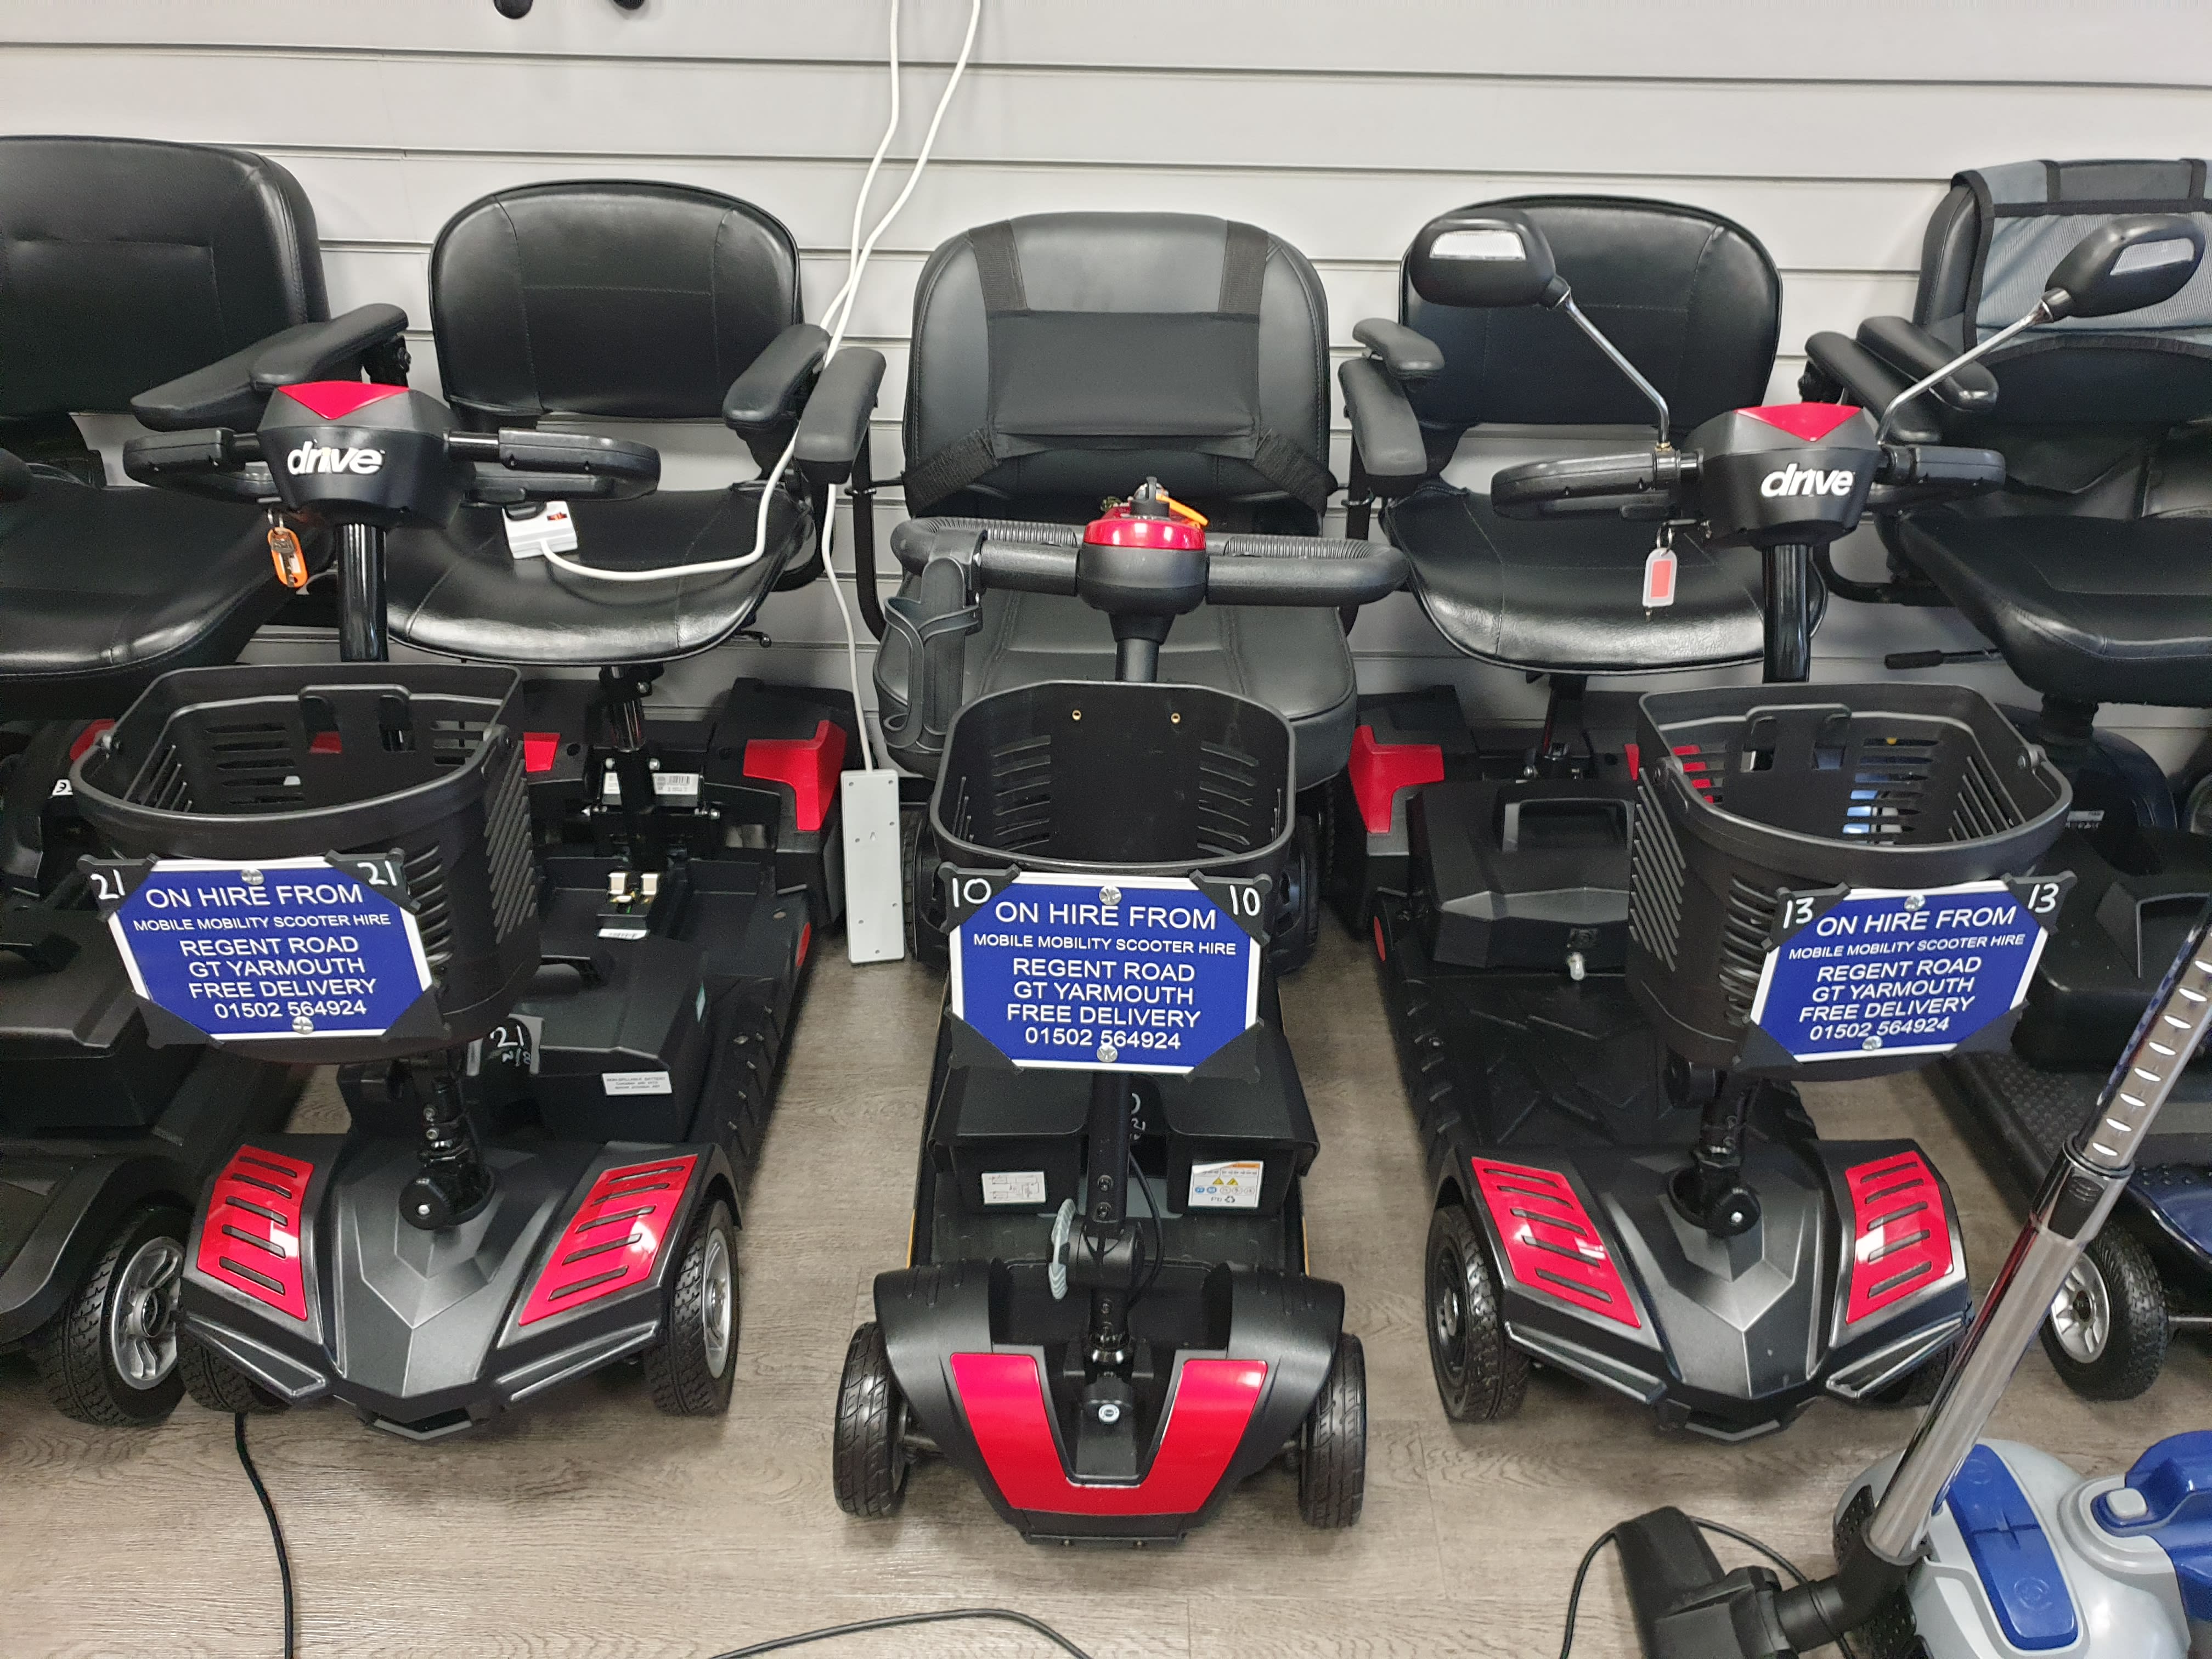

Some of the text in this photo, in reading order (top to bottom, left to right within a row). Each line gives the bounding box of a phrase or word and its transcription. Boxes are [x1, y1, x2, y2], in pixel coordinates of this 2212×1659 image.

[287, 441, 383, 475] drive
[1761, 463, 1854, 497] drive
[91, 870, 125, 900] 21
[357, 860, 397, 886] 21
[146, 884, 363, 908] ON HIRE FROM
[952, 878, 991, 907] 10
[1230, 885, 1260, 916] 10
[2028, 883, 2059, 913] 13
[133, 914, 391, 930] MOBILE MOBILITY SCOOTER HIRE
[996, 901, 1215, 930] ON HIRE FROM
[1783, 897, 1814, 929] 13
[1817, 906, 2016, 936] ON HIRE FROM
[180, 936, 358, 956] REGENT ROAD
[974, 934, 1235, 955] MOBILE MOBILITY SCOOTER HIRE
[1789, 934, 2025, 959] MOBILE MOBILITY SCOOTER HIRE
[189, 957, 365, 977] GT YARMOUTH
[1014, 958, 1194, 981] REGENT ROAD
[1817, 957, 1982, 982] REGENT ROAD
[189, 979, 376, 998] FREE DELIVERY
[1014, 981, 1193, 1005] GT YARMOUTH
[1813, 977, 1975, 1002] GT YARMOUTH
[215, 1000, 366, 1018] 01502 564924
[1008, 1004, 1200, 1028] FREE DELIVERY
[1799, 996, 1975, 1022] FREE DELIVERY
[489, 1025, 524, 1047] 21
[1025, 1027, 1181, 1049] 01502 564924
[1810, 1017, 1949, 1041] 01502 564924
